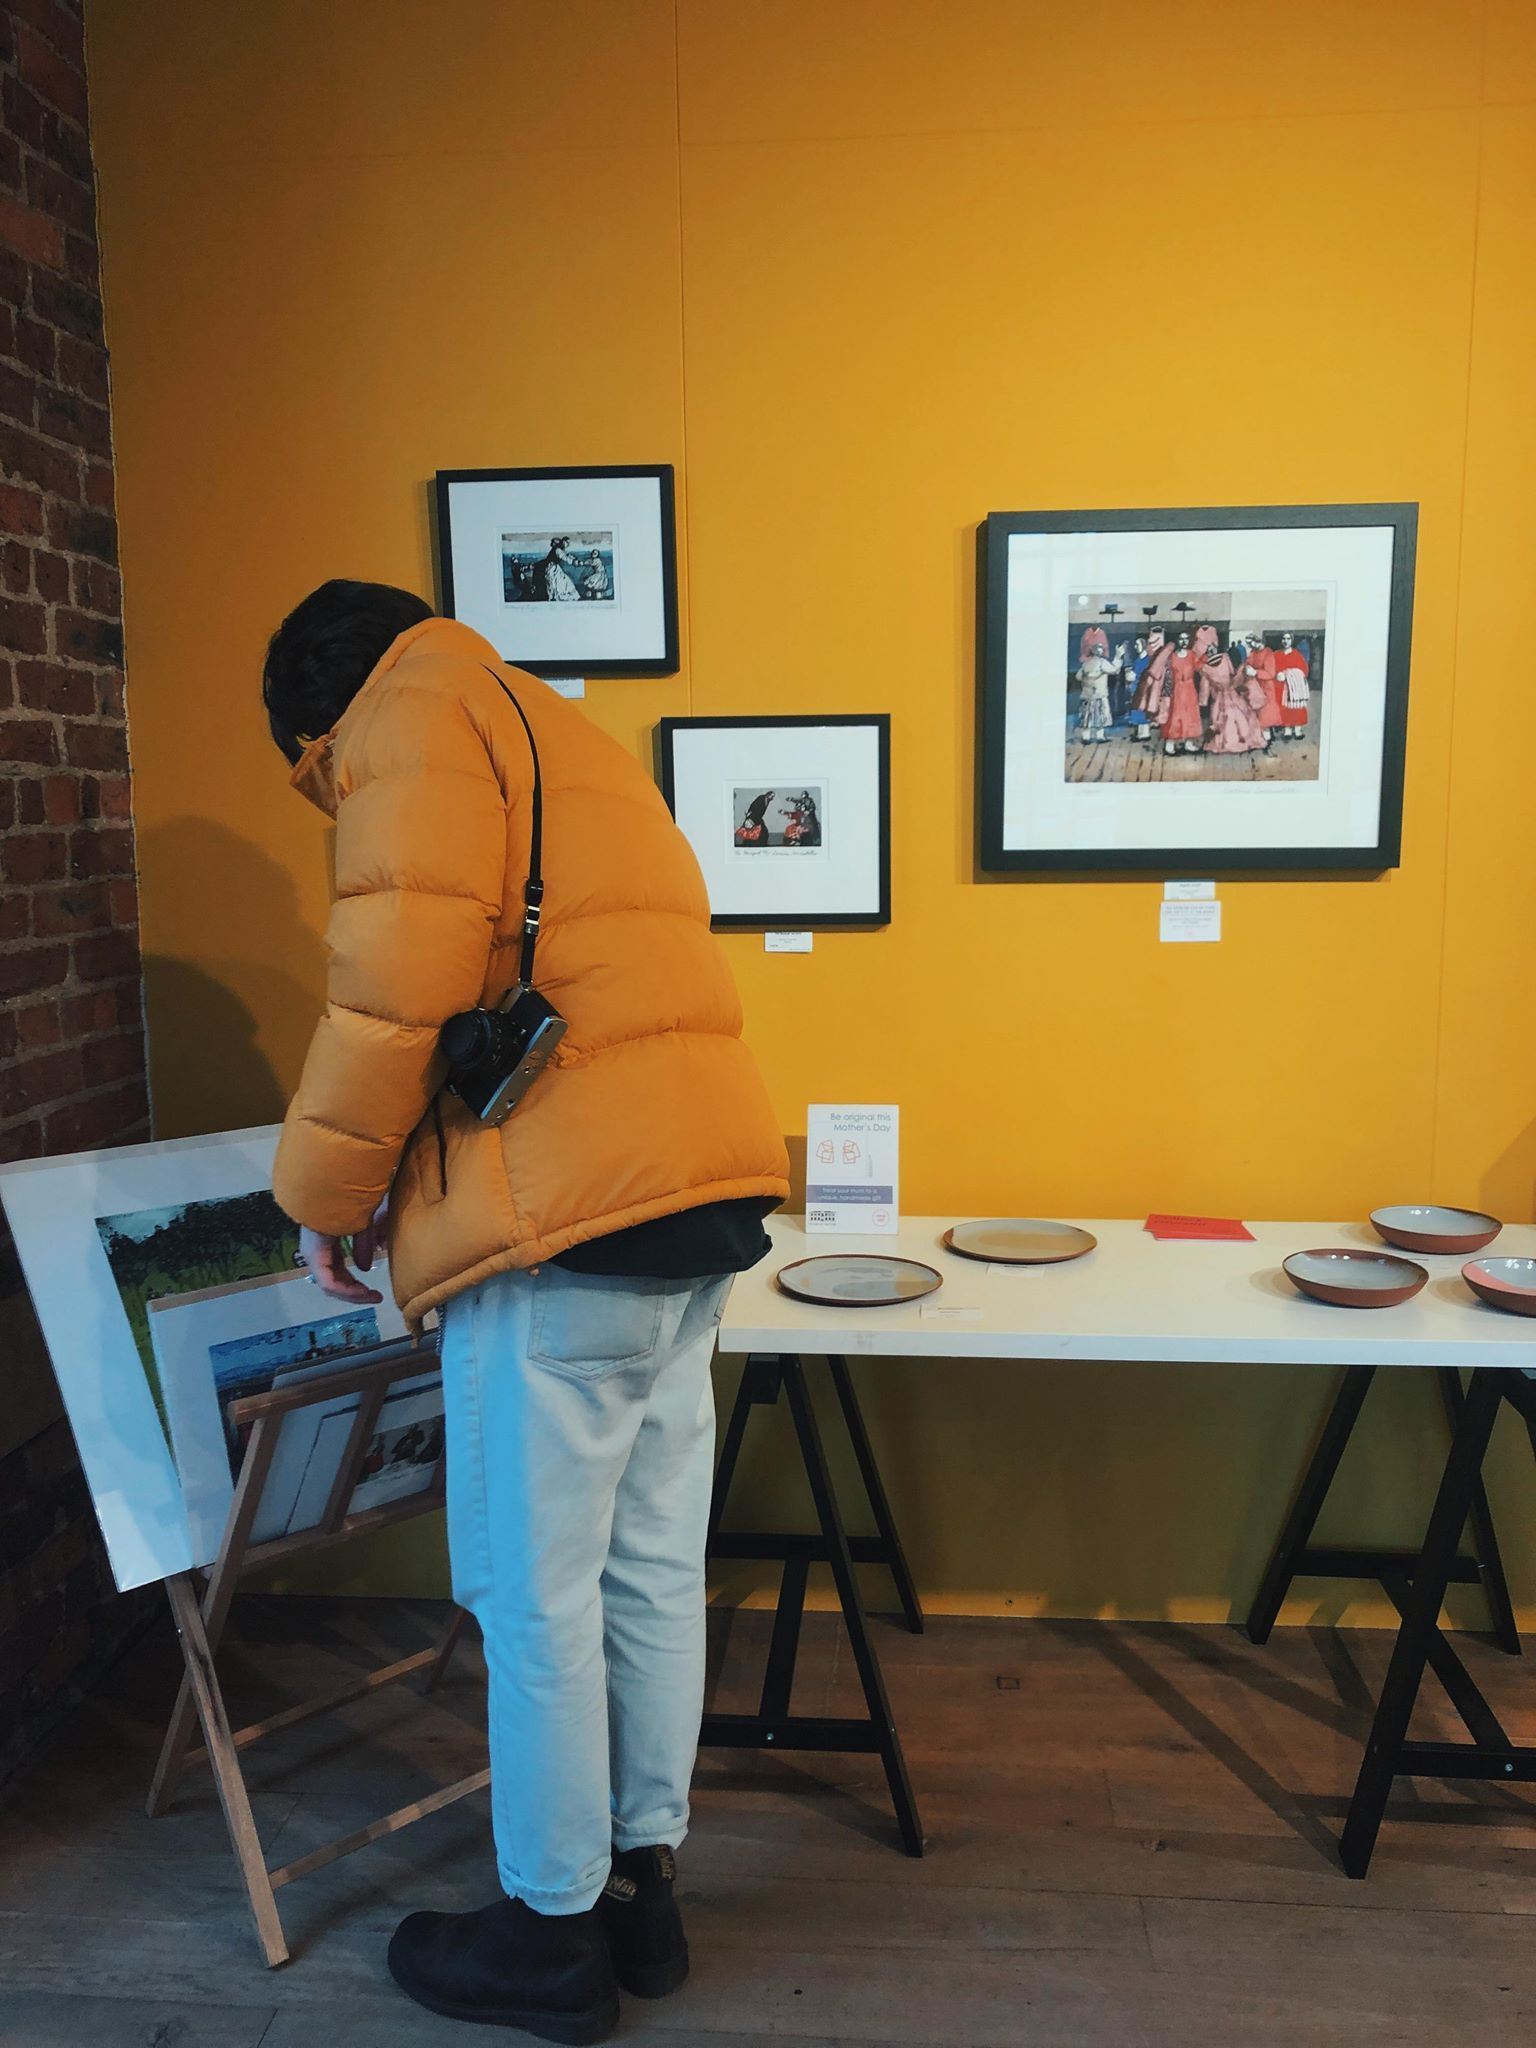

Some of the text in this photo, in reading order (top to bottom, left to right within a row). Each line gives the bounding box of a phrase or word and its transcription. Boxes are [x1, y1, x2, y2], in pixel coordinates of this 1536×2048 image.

[830, 1112, 891, 1122] Be original this
[833, 1123, 892, 1133] Mother's Day
